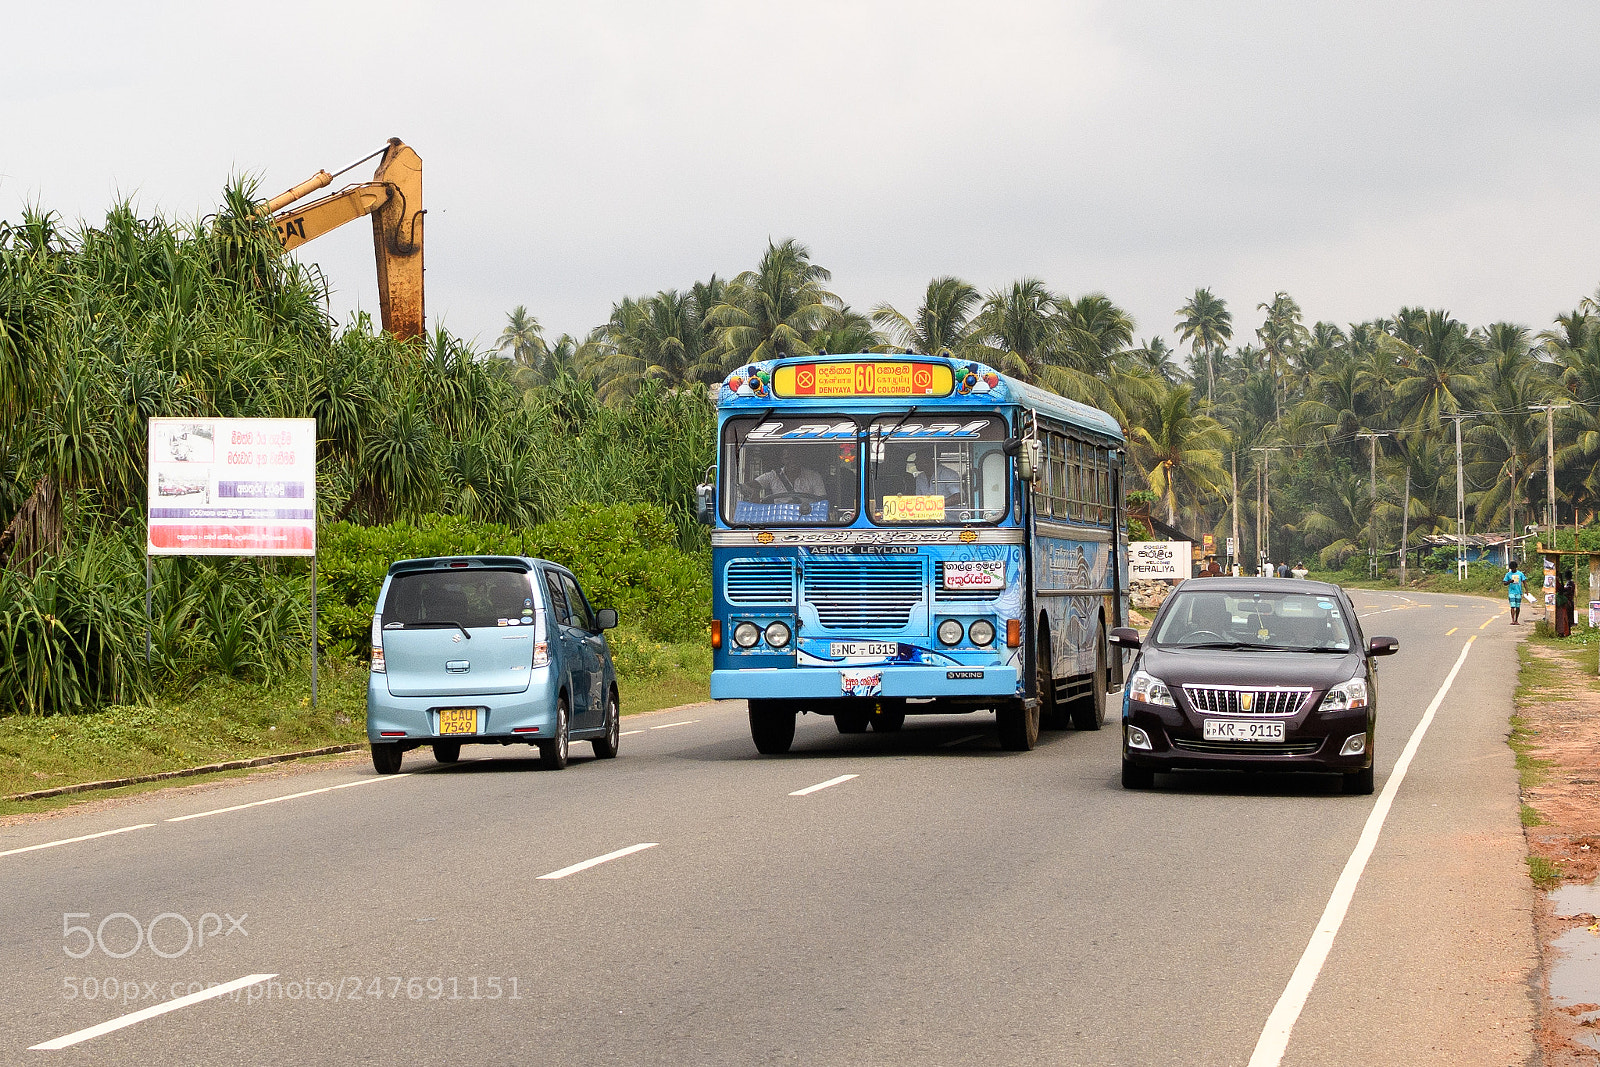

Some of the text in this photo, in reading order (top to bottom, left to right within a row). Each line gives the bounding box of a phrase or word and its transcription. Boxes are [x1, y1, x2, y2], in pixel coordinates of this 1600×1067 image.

[855, 366, 875, 392] 60
[818, 386, 851, 394] DENIYAYA
[877, 386, 911, 394] COLOMBO
[883, 500, 897, 516] 60
[811, 546, 917, 554] ASHOK LEYLAND
[1132, 565, 1175, 573] PERALIYA
[842, 644, 857, 655] NC
[868, 644, 896, 655] 0315
[450, 710, 473, 722] CAU
[444, 721, 472, 733] 7549
[1218, 723, 1235, 736] KR
[1249, 724, 1282, 738] 9115
